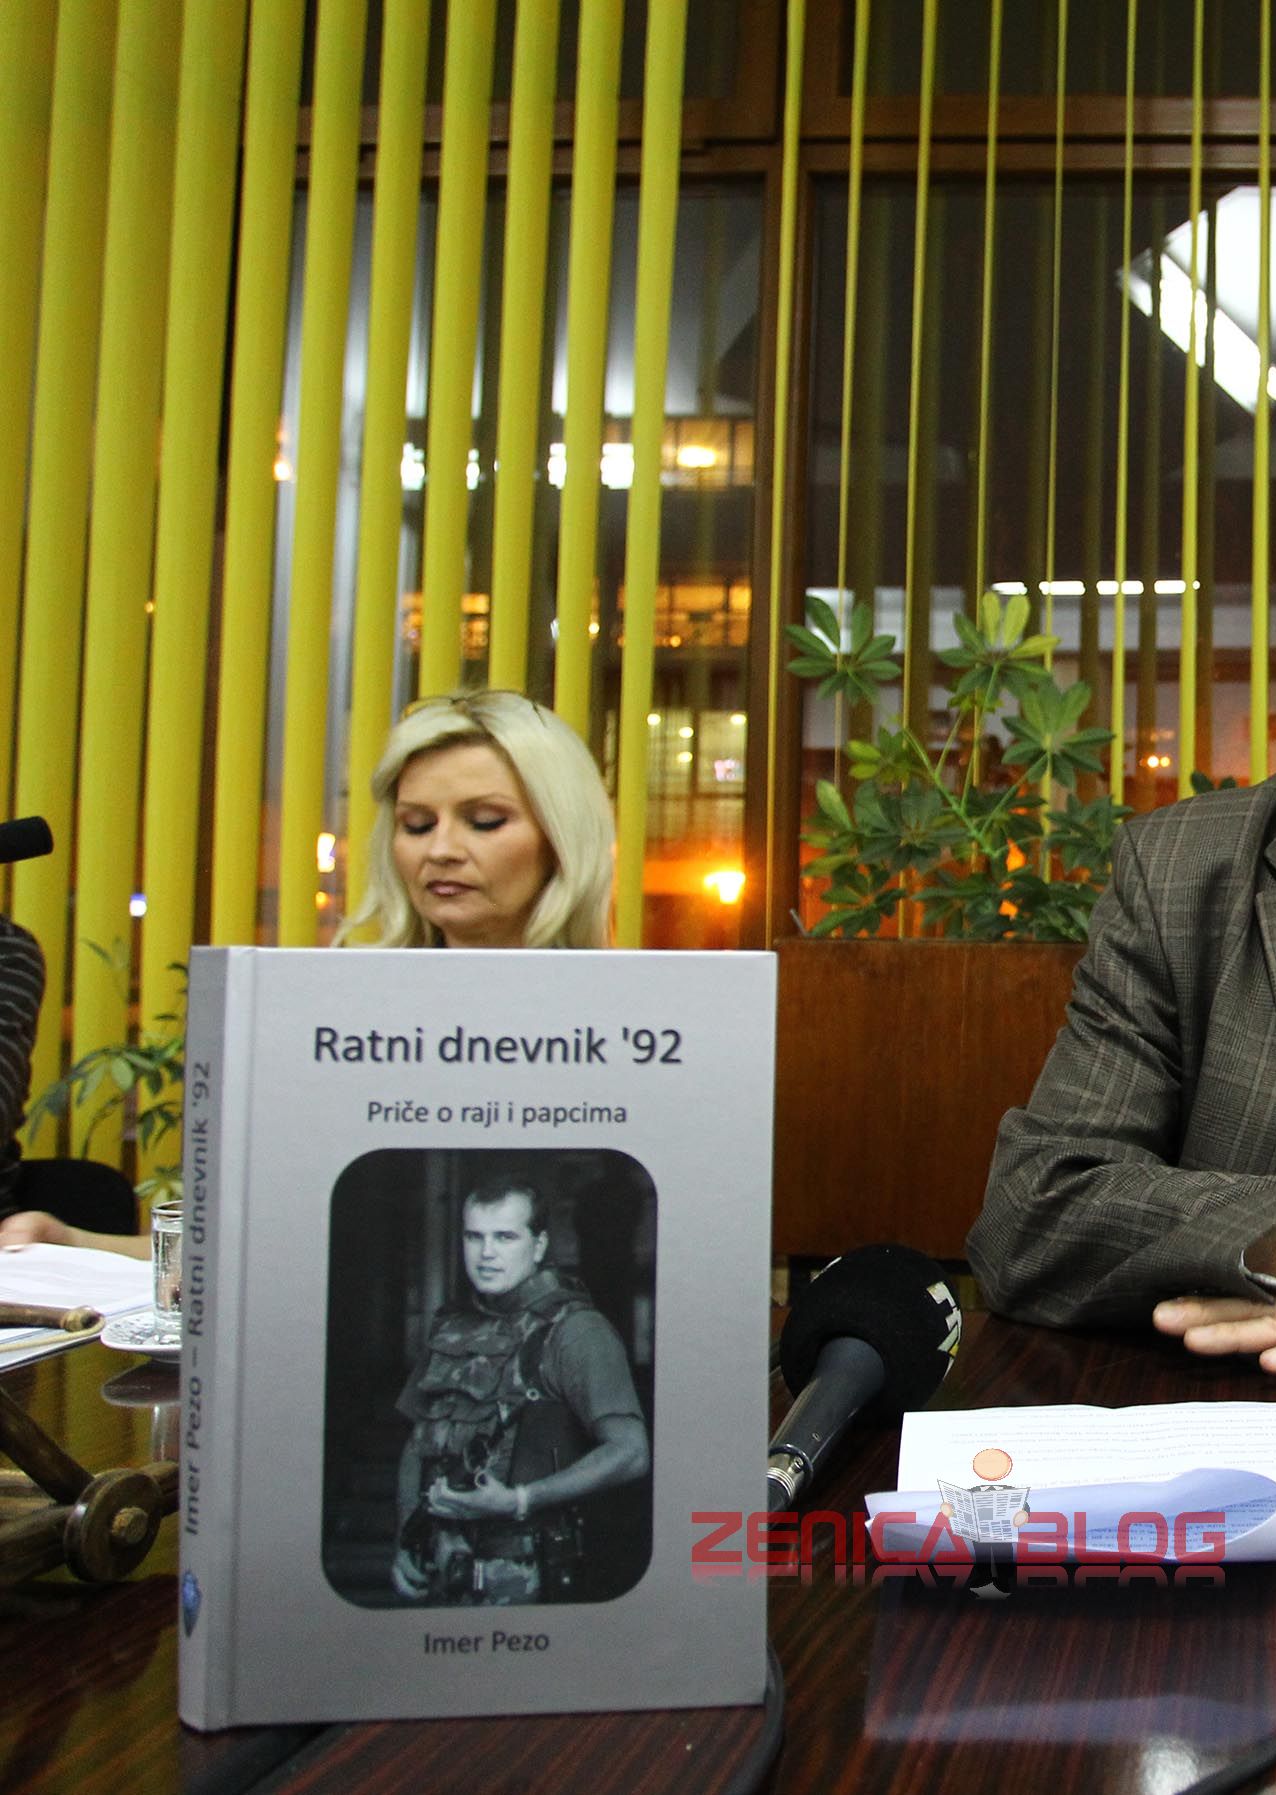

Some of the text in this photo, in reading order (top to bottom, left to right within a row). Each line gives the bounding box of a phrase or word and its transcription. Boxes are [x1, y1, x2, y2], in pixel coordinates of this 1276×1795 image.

[313, 1026, 683, 1065] Ratni dnevnik '92
[192, 1061, 210, 1107] '92
[367, 1100, 627, 1128] Priče o raji i papcima
[190, 1118, 209, 1246] dnevnik
[188, 1254, 205, 1337] Ratni
[186, 1376, 202, 1450] Pezo
[184, 1462, 200, 1536] Imer
[424, 1630, 550, 1654] Imer Pezo
